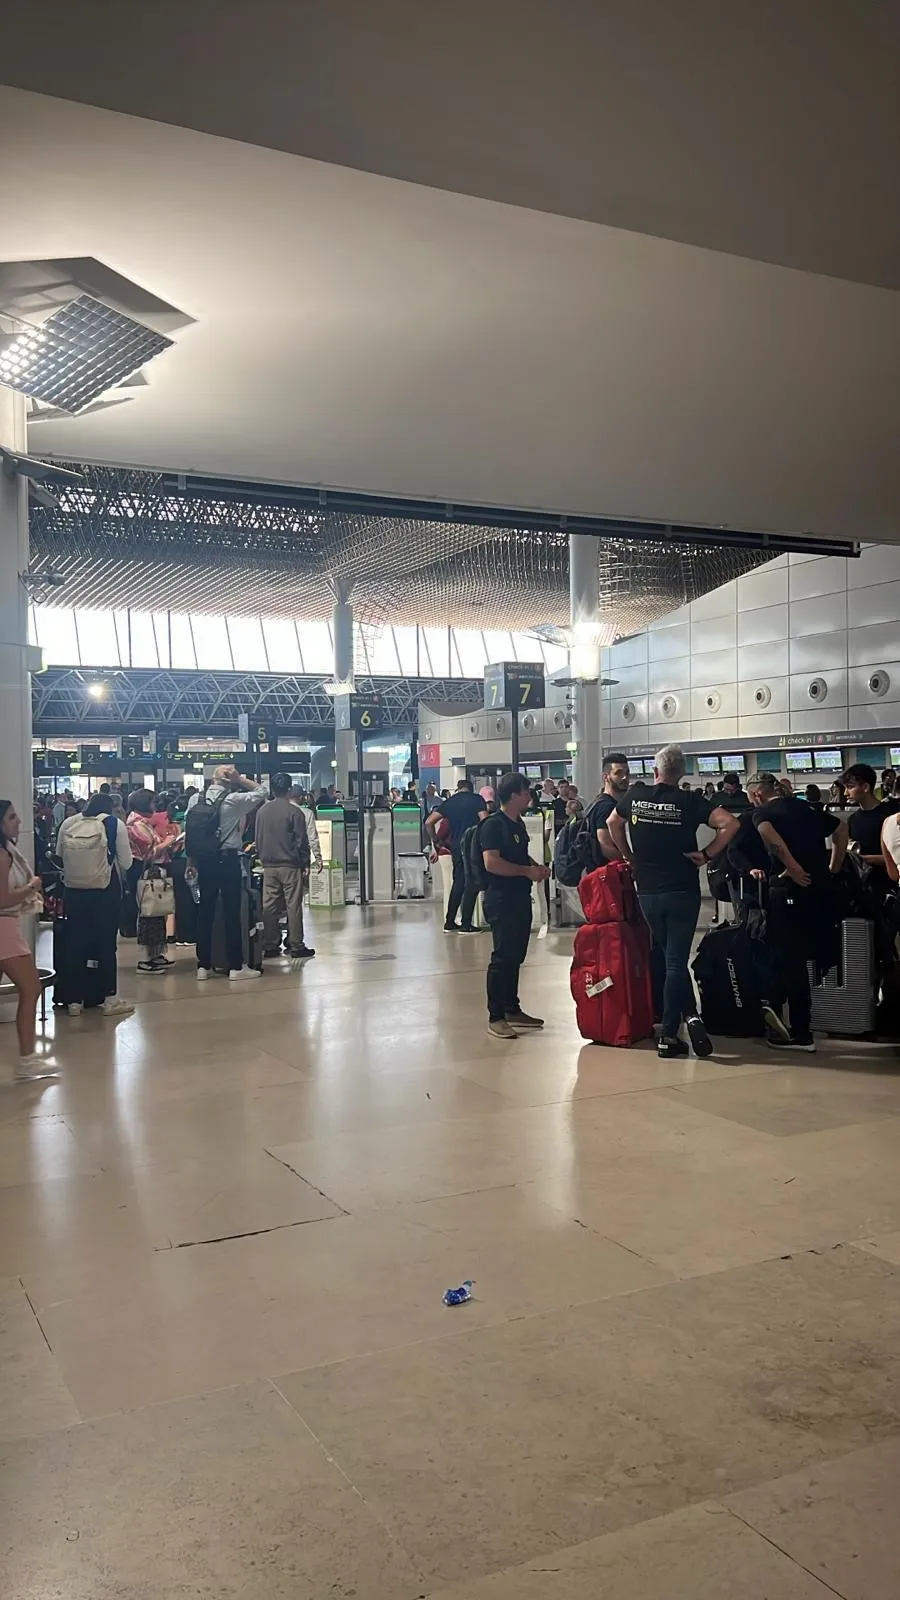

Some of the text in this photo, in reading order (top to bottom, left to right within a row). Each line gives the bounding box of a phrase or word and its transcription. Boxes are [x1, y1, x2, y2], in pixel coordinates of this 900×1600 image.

[491, 684, 497, 706] 7
[519, 683, 531, 704] 7
[360, 710, 371, 727] 6
[258, 727, 266, 740] 5
[787, 736, 812, 745] check-in
[128, 747, 136, 757] 3
[163, 742, 171, 752] 4
[87, 753, 94, 762] 2
[631, 800, 682, 812] MERTEL
[726, 957, 743, 1008] BHAITECH
